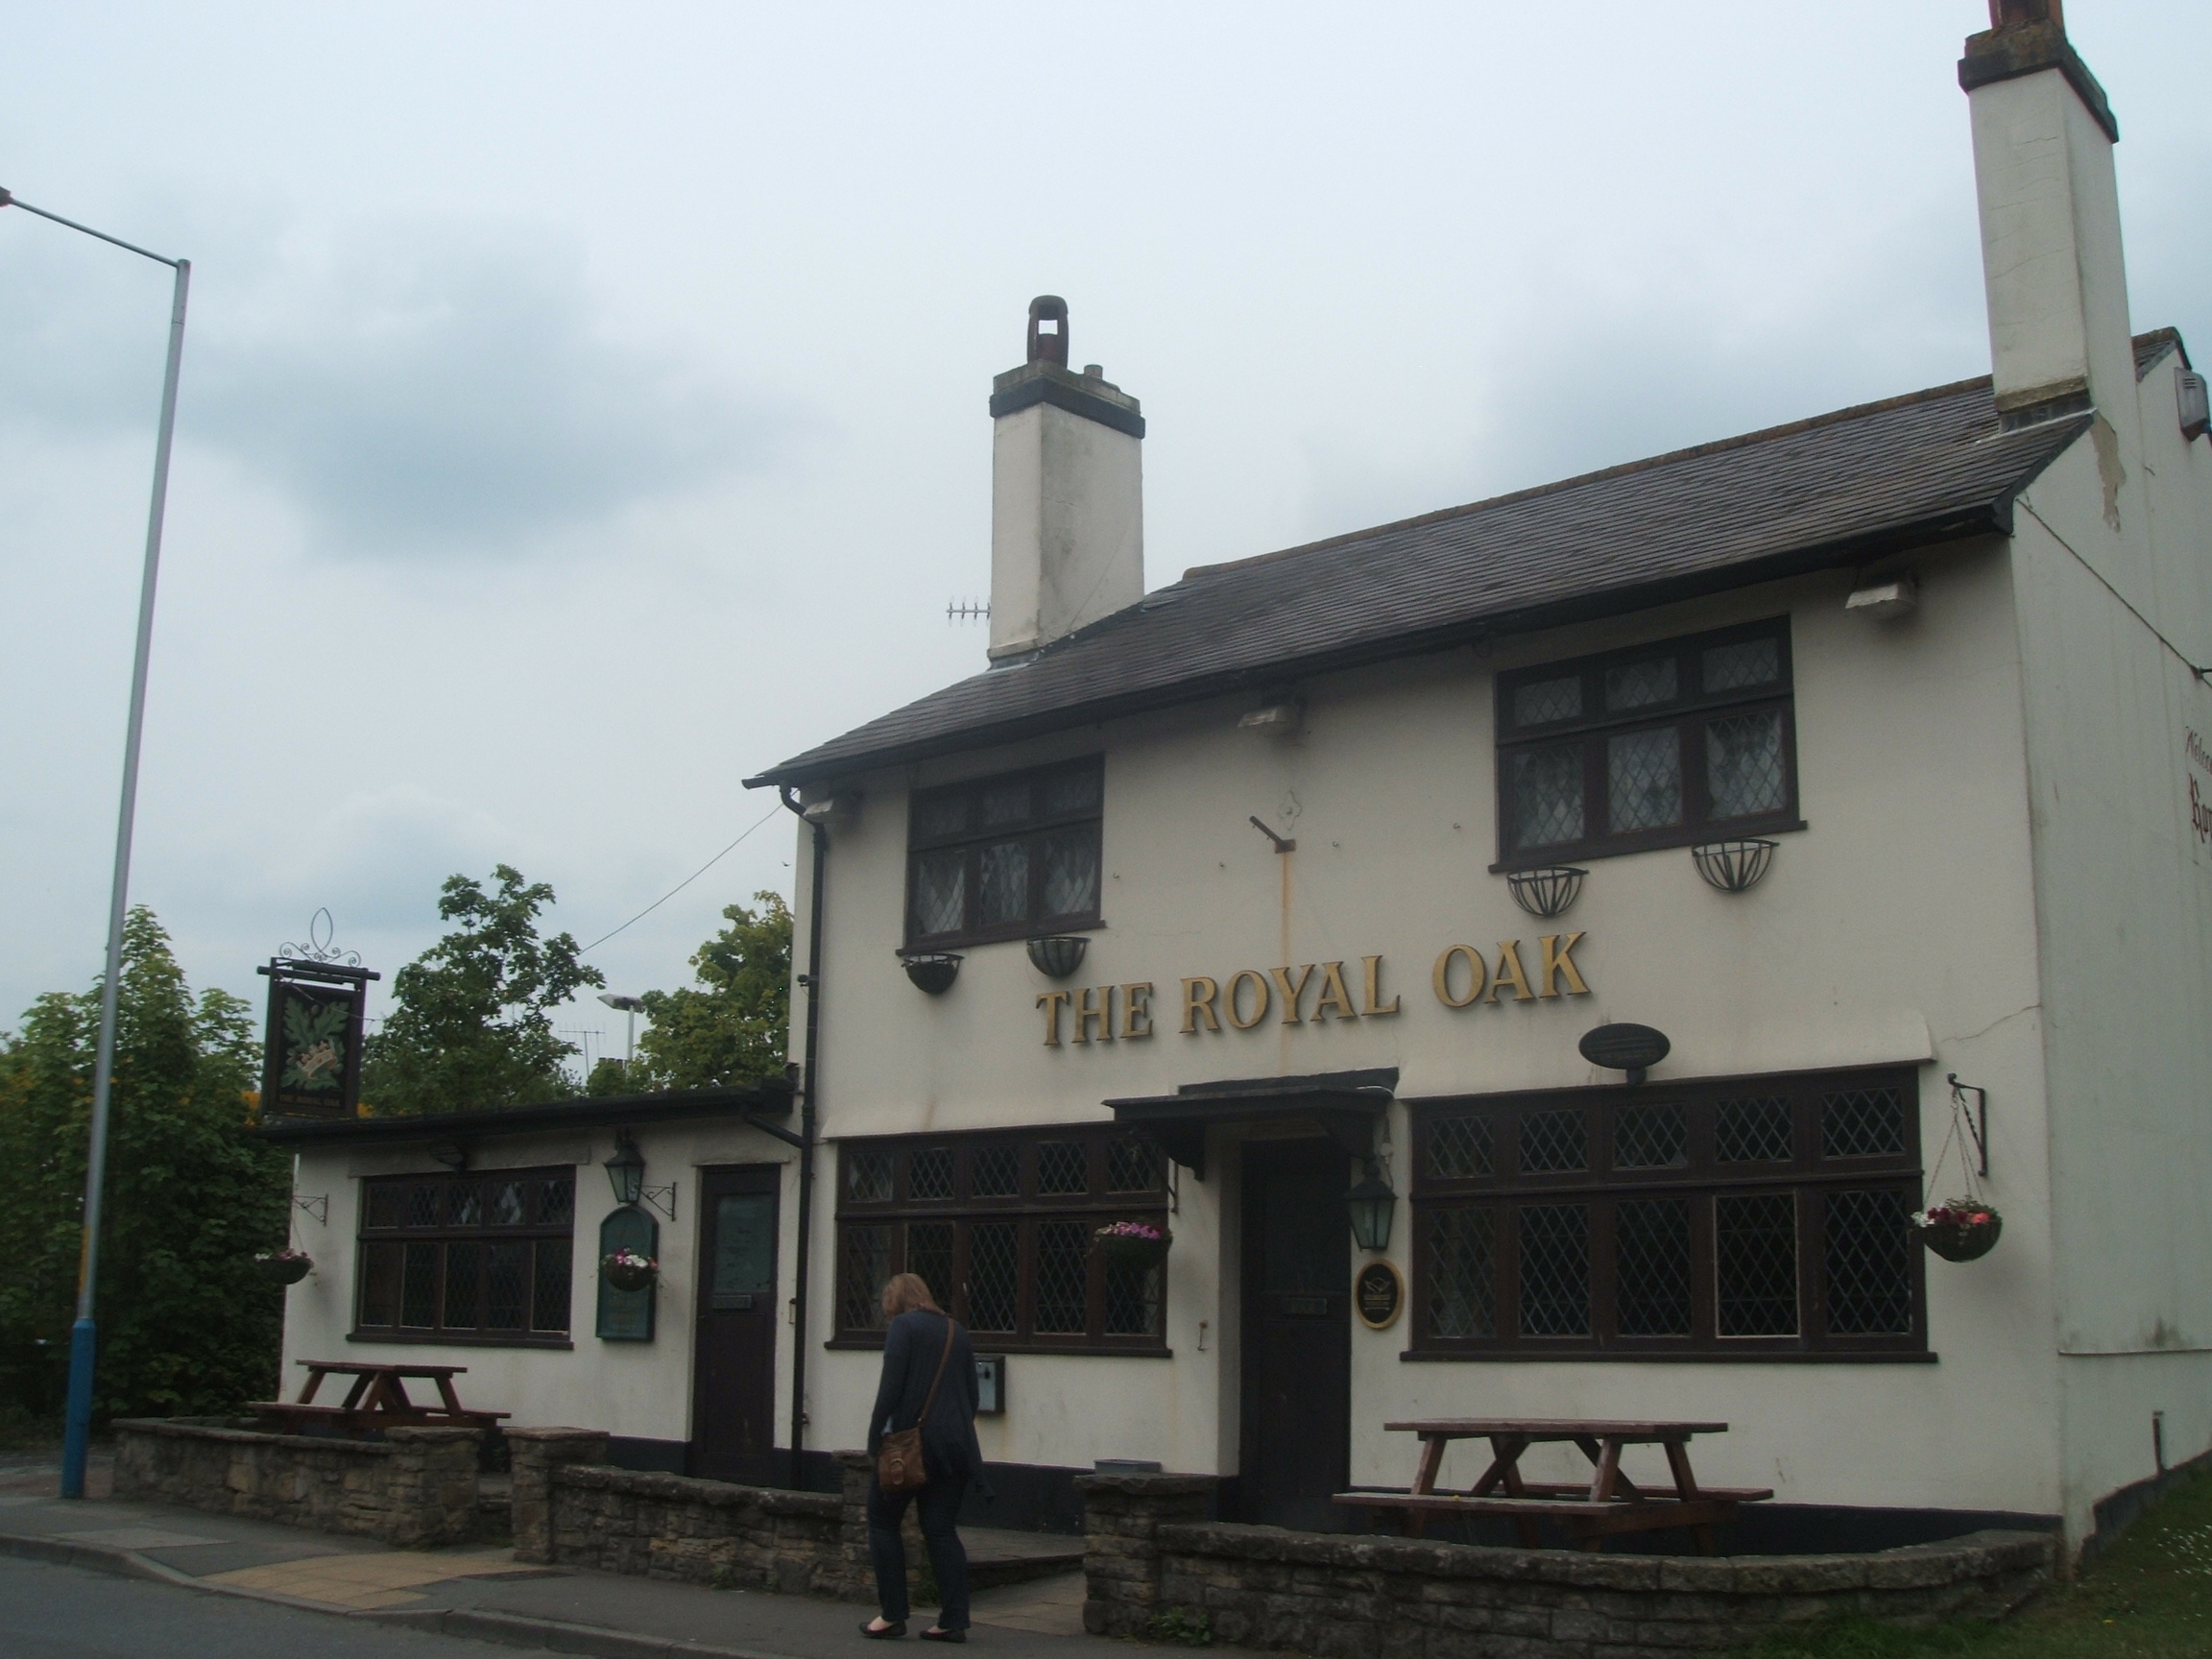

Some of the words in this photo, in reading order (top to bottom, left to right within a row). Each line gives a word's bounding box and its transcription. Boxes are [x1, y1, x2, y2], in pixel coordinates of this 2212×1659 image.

[1036, 981, 1154, 1046] THE
[1179, 954, 1401, 1034] ROYAL
[1432, 931, 1592, 1008] OAK
